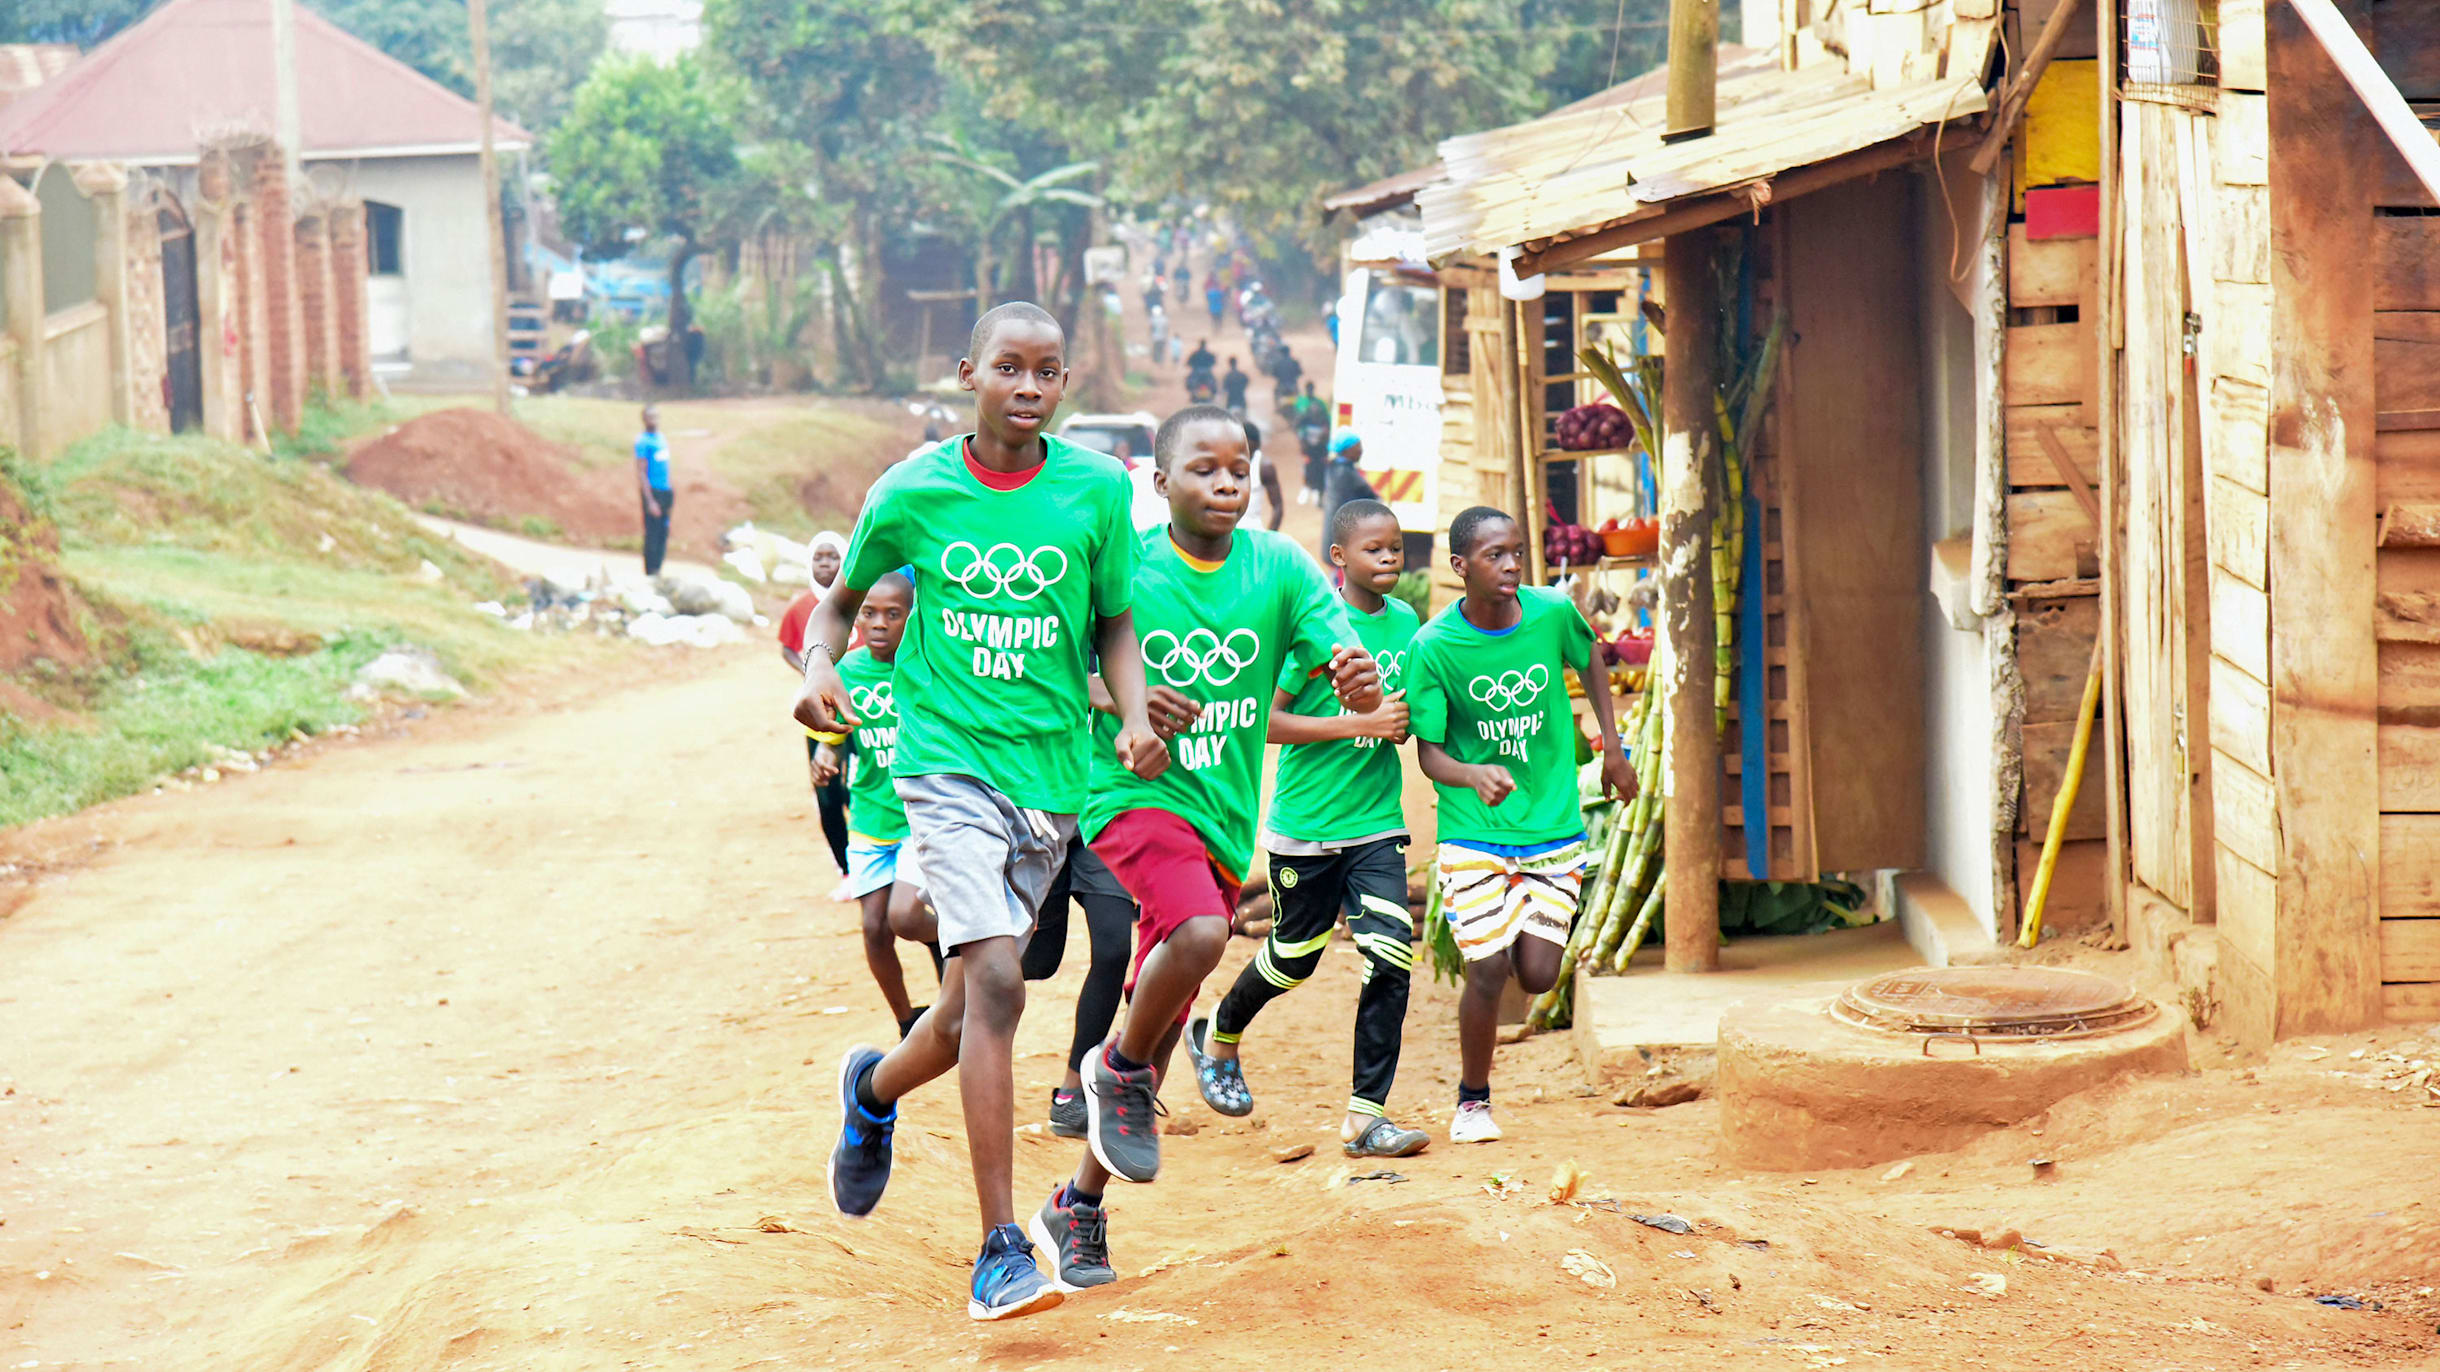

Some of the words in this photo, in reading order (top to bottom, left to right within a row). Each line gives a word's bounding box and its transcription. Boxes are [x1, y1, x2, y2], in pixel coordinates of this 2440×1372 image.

[942, 608, 1059, 649] OLYMPIC
[972, 647, 1025, 680] DAY
[1162, 697, 1257, 735] MPIC
[858, 726, 898, 749] OLYM
[1178, 734, 1228, 771] DAY
[1499, 739, 1528, 763] DAY
